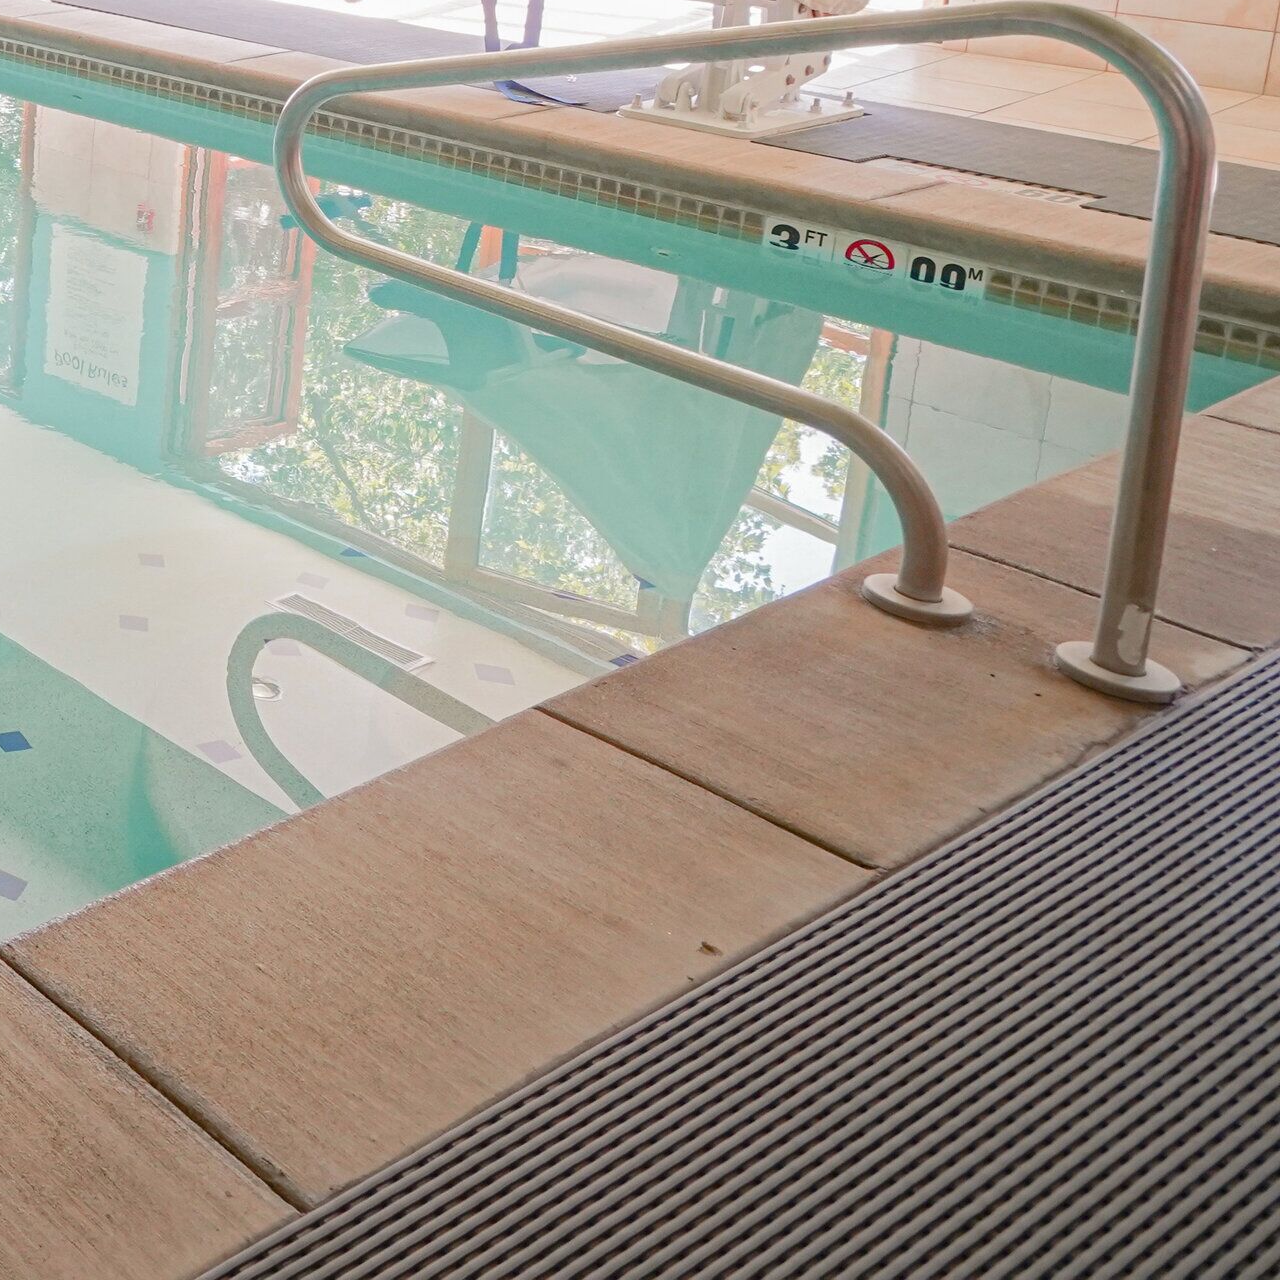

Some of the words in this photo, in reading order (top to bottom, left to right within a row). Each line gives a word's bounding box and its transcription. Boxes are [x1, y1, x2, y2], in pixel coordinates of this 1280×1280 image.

[769, 223, 801, 251] 3
[805, 230, 828, 247] FT
[968, 267, 983, 282] M
